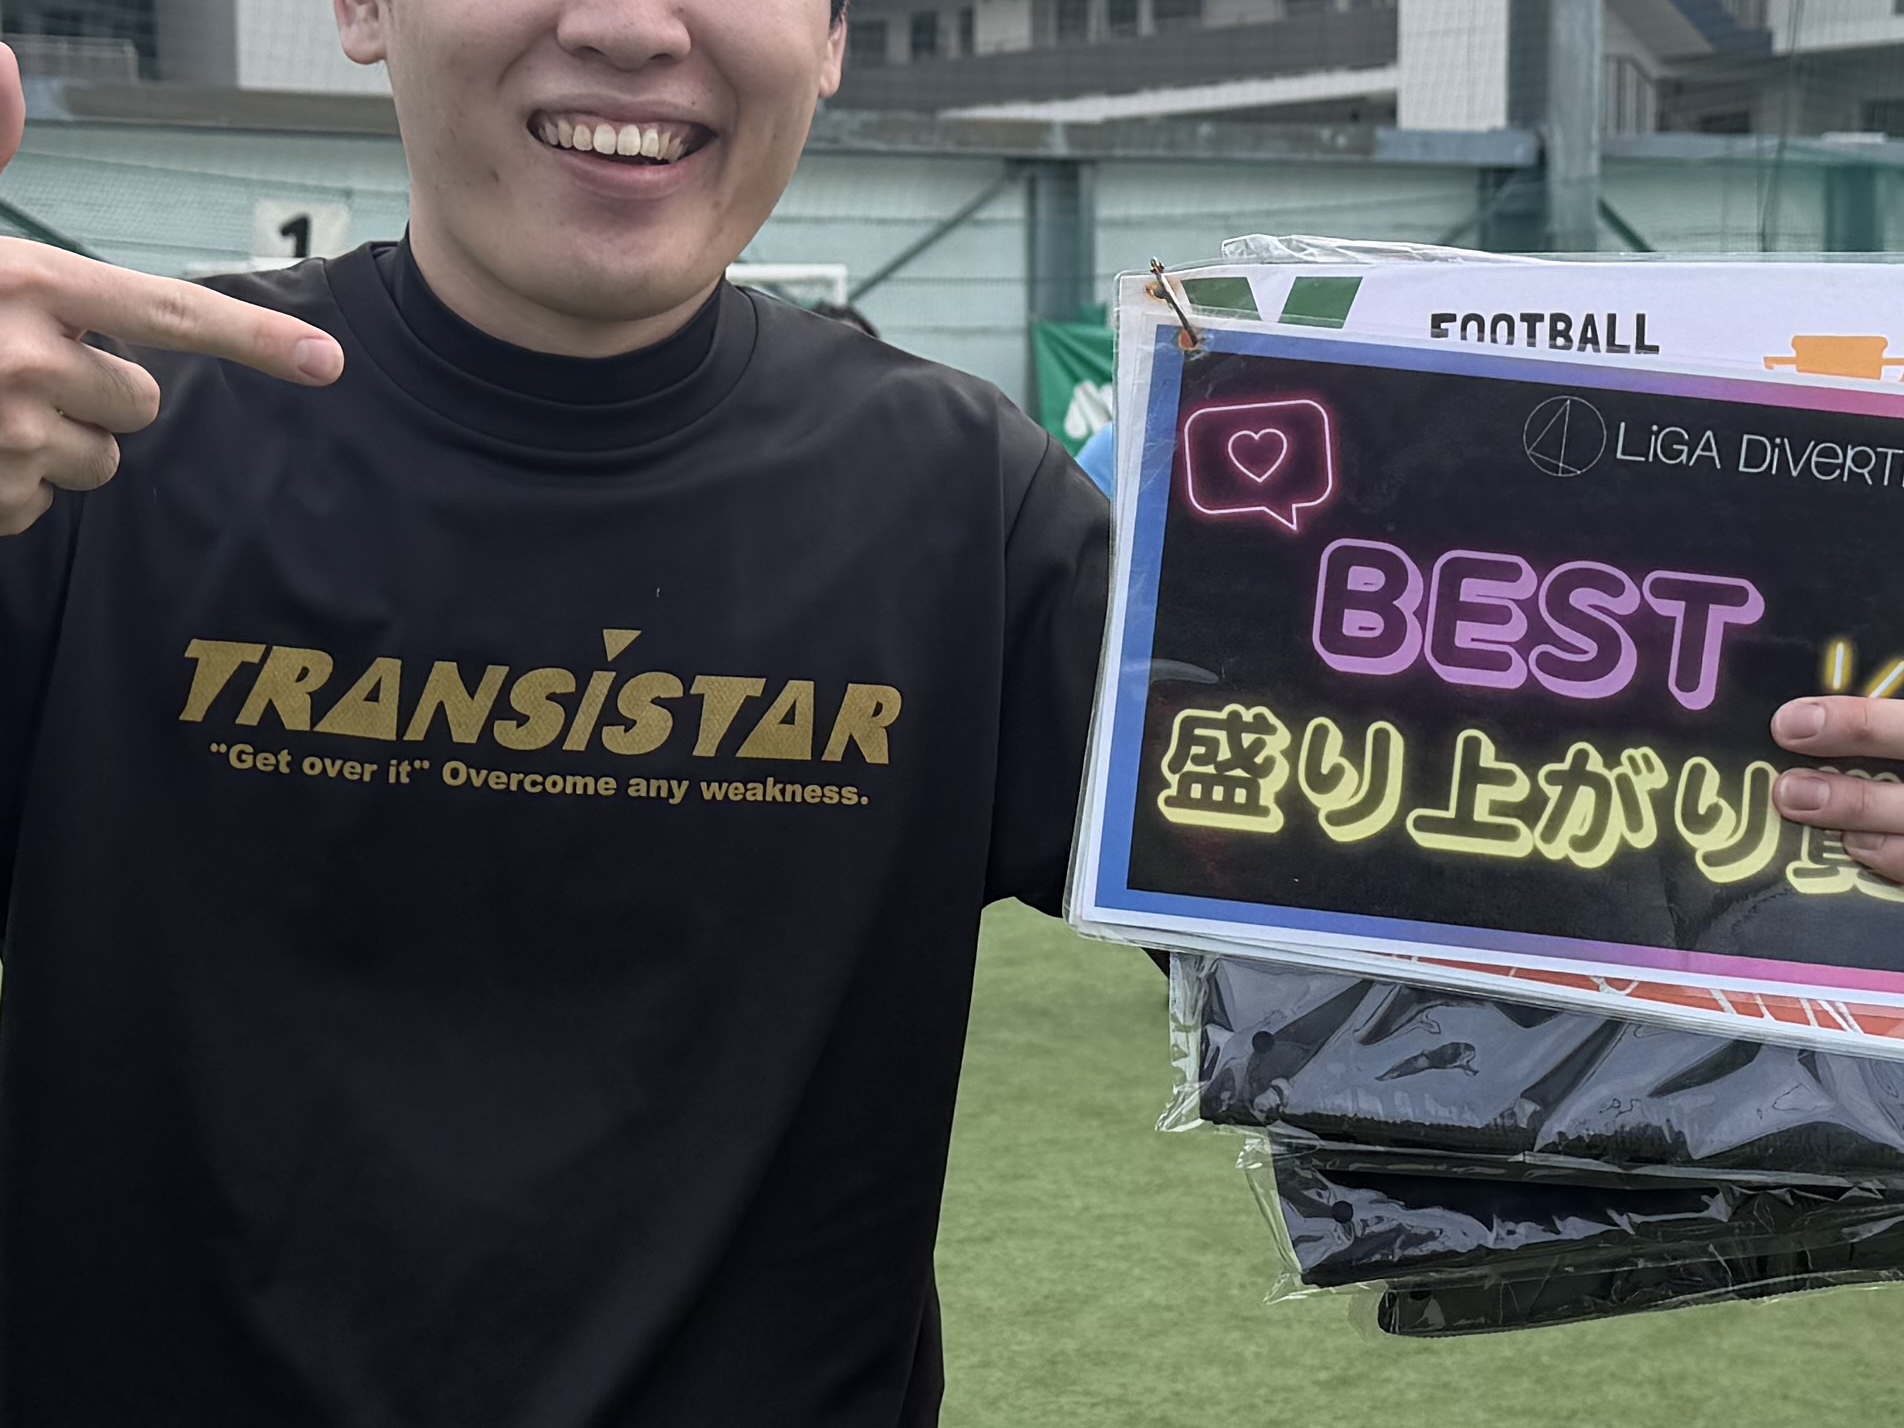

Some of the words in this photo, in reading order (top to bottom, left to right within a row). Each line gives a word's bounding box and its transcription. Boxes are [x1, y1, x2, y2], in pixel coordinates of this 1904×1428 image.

[280, 212, 310, 258] 1
[1429, 312, 1660, 355] FOOTBALL
[1312, 537, 1765, 712] BEST
[209, 742, 291, 774] "Get
[301, 753, 378, 783] over
[387, 758, 431, 785] it"
[442, 760, 617, 797] Overcome
[627, 777, 690, 805] any
[700, 776, 870, 807] weakness.
